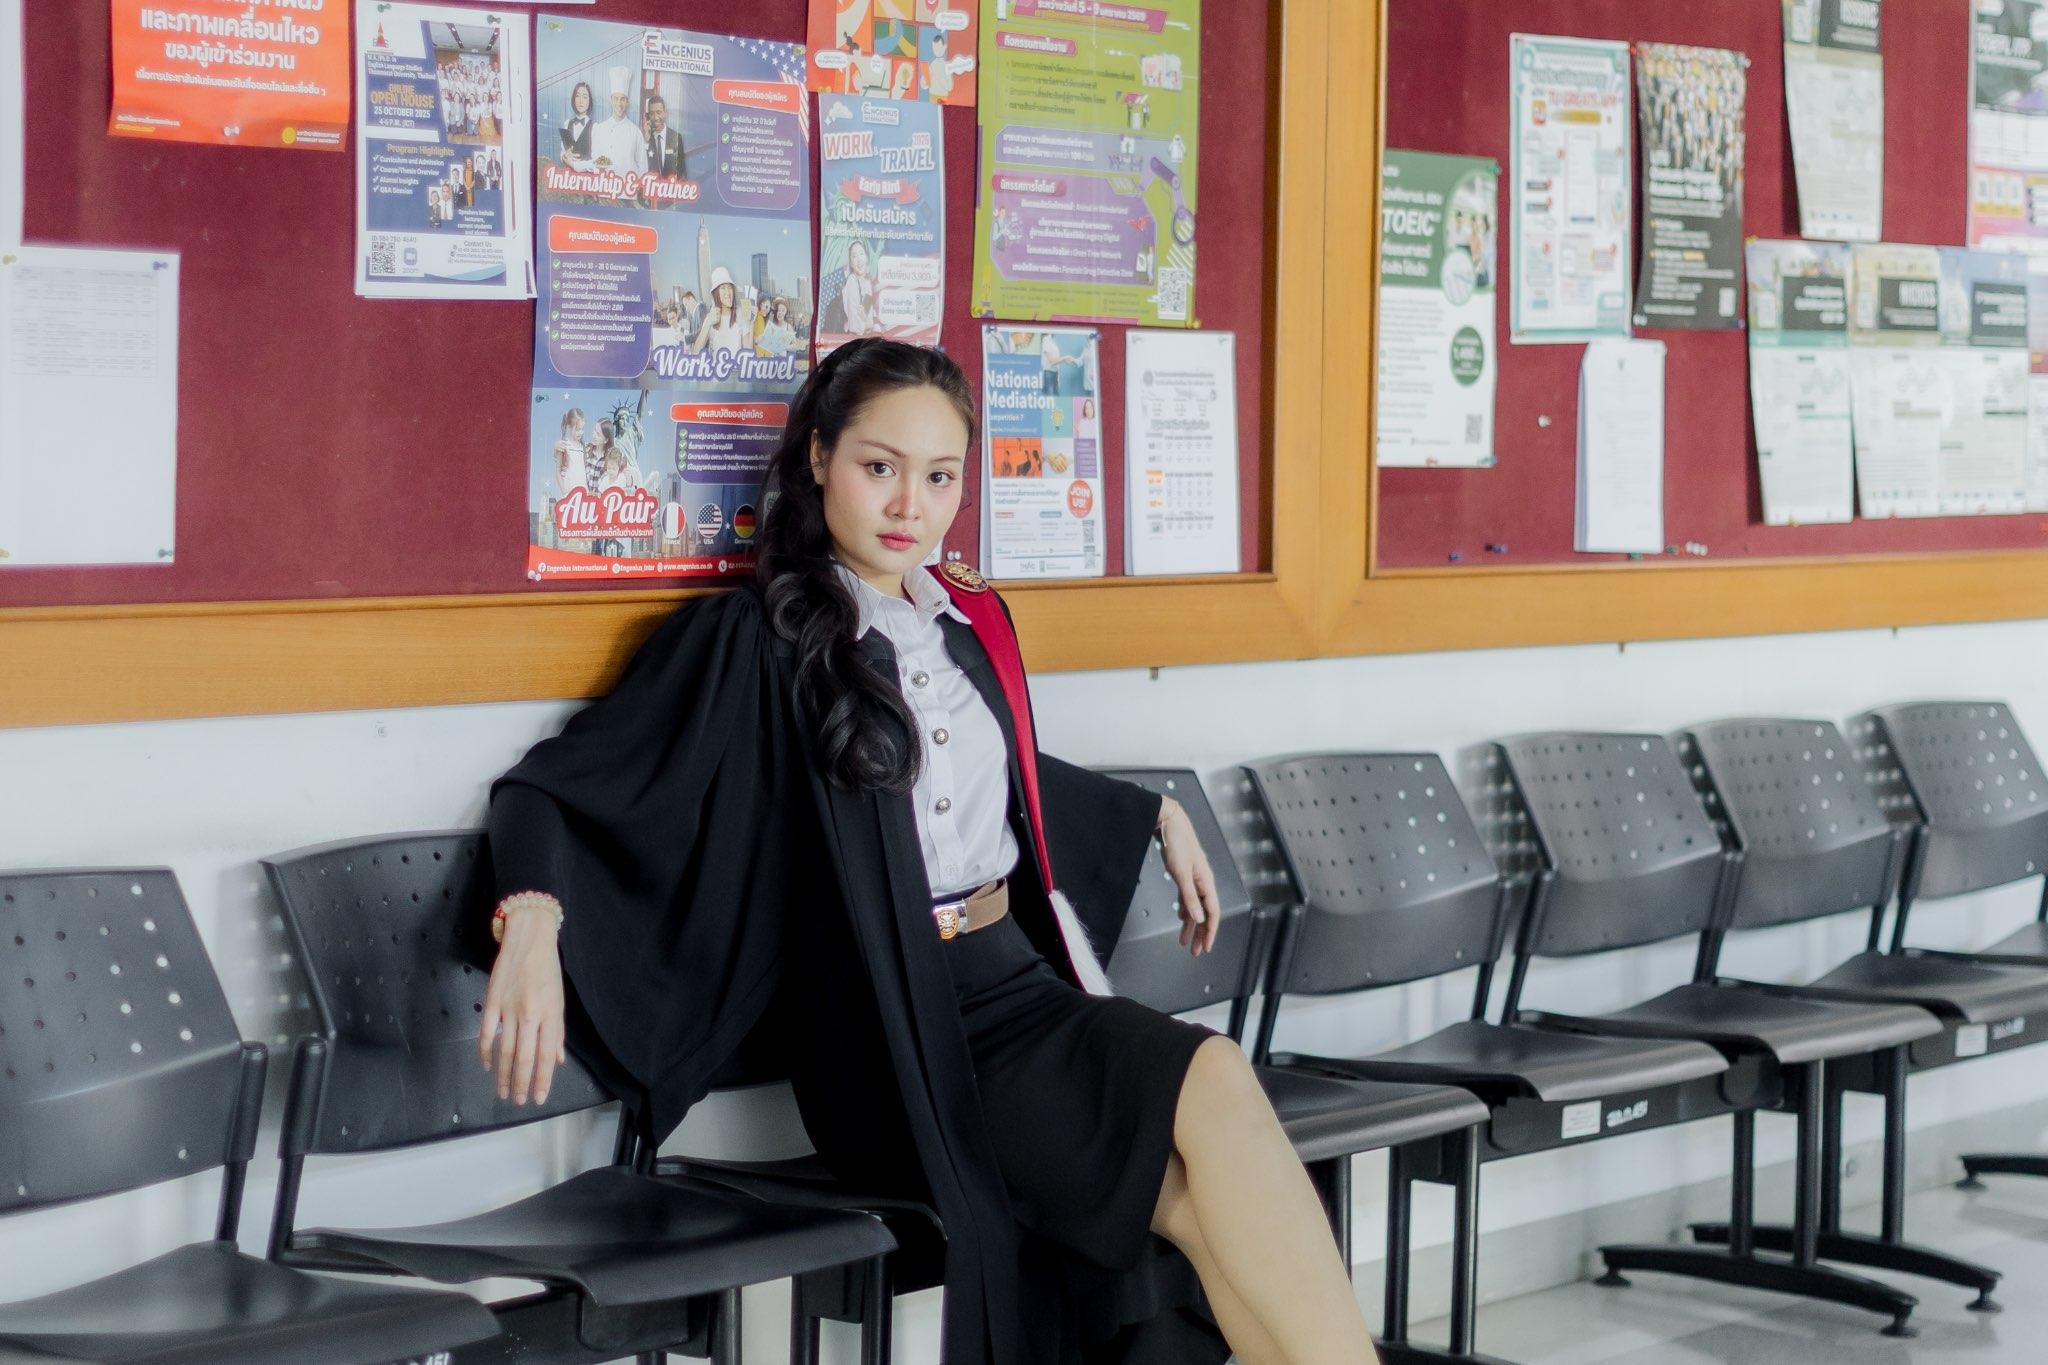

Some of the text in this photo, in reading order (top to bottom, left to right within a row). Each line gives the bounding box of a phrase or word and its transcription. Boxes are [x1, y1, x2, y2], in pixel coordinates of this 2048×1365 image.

[140, 6, 320, 45] และภาพเคลื่อนไหว
[165, 40, 295, 70] ของผู้เข้าร่วมงาน
[645, 35, 712, 61] ENGENIUS
[368, 61, 384, 69] English
[386, 63, 405, 71] Language
[645, 58, 712, 73] INTERNATIONAL
[418, 72, 436, 80] Thailand
[389, 84, 415, 94] ONLINE
[728, 89, 788, 104] คุณสมบัติของผู้สมัคร
[371, 91, 434, 109] OPEN HOUSE
[374, 106, 431, 119] 25 OCTOBER 2025
[387, 143, 455, 157] Program Highlights
[824, 132, 871, 160] WORK
[881, 148, 934, 172] TRAVEL
[380, 156, 408, 164] Curriculum
[419, 159, 445, 167] Admission
[417, 168, 440, 176] Overview
[380, 176, 419, 186] Alumni Insights
[546, 167, 698, 200] Internship & Trainee
[859, 177, 900, 195] Early Bird
[393, 187, 413, 195] Session
[842, 202, 917, 226] เปิดรับสมัคร
[568, 230, 636, 245] คุณสมบัติของผู้สมัคร
[653, 348, 796, 380] Work & Travel
[985, 369, 1044, 389] National
[986, 390, 1056, 410] Mediation
[697, 408, 764, 421] คุณสมบัติของผู้สมัคร
[1070, 486, 1090, 497] JOIN
[559, 492, 655, 528] Au Pair
[546, 564, 608, 573] Engenius International
